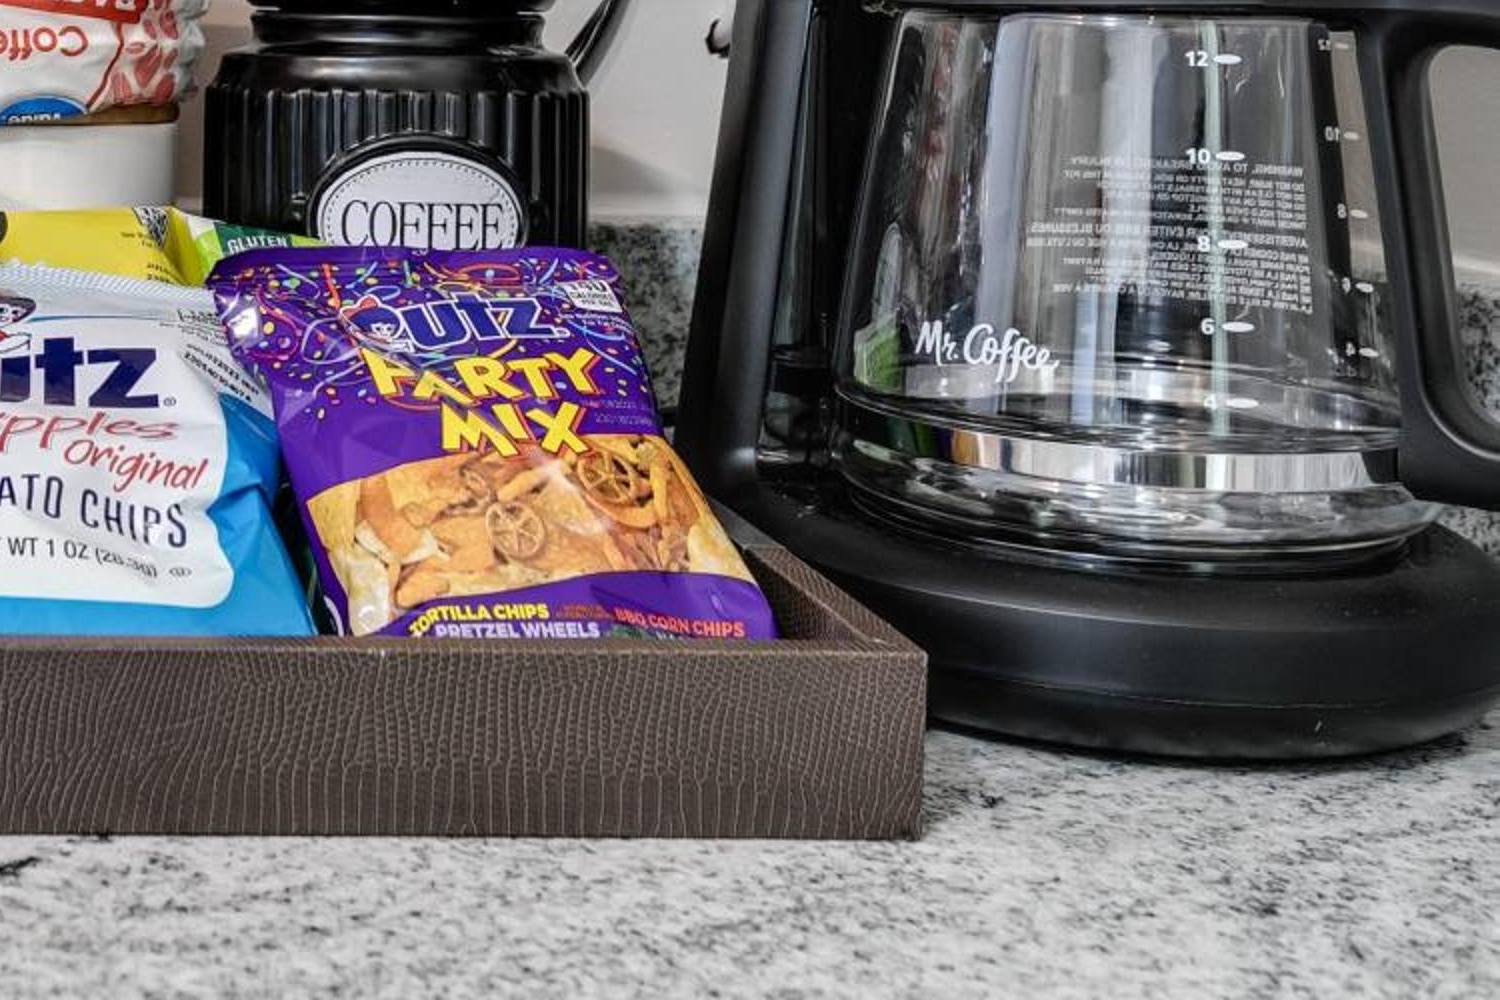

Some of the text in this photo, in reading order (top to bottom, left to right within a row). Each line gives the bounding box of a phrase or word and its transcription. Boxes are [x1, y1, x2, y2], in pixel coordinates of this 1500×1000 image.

[1185, 50, 1208, 67] 12
[1185, 147, 1211, 165] 10
[341, 199, 503, 250] COFFEE
[227, 236, 288, 255] GLUTEN
[1198, 234, 1211, 251] 8
[1201, 317, 1215, 335] 6
[915, 320, 1061, 384] Mr. Coffee
[361, 347, 598, 405] PARTY
[440, 401, 590, 458] MIX
[63, 438, 209, 494] Original
[80, 488, 188, 549] CHIPS
[7, 537, 39, 557] WT
[46, 539, 55, 557] 1
[63, 540, 91, 561] OZ
[409, 603, 492, 638] TORTILLA
[492, 603, 550, 621] CHIPS
[435, 622, 519, 639] PRETZEL
[520, 622, 601, 639] WHEELS
[648, 613, 691, 634] CORN
[693, 620, 746, 638] CHIPS
